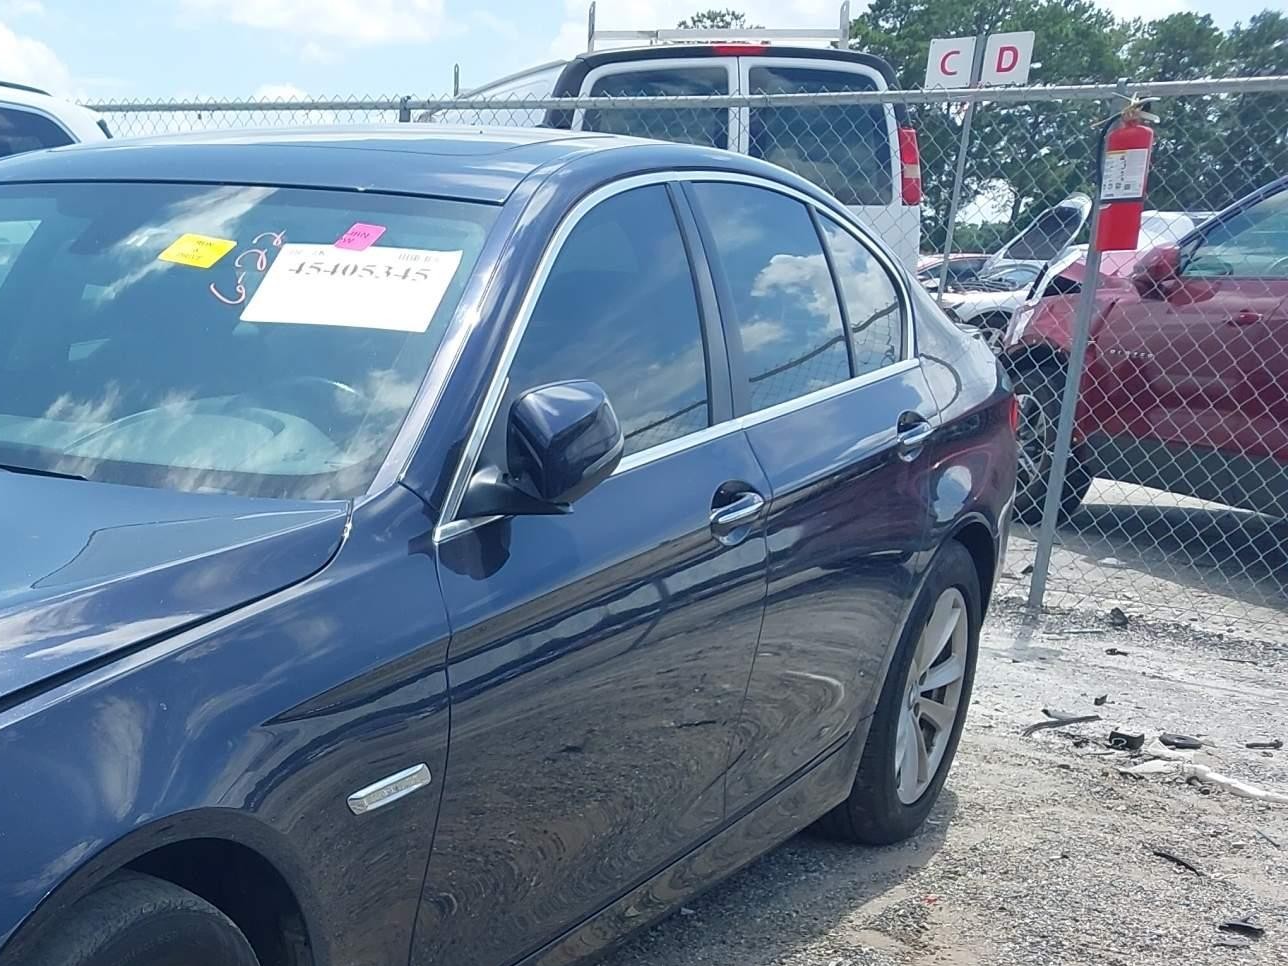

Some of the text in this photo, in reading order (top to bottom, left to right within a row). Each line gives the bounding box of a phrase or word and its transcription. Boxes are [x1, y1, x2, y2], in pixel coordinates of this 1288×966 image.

[940, 50, 961, 76] C
[995, 46, 1019, 73] D
[288, 260, 433, 283] 45405345
